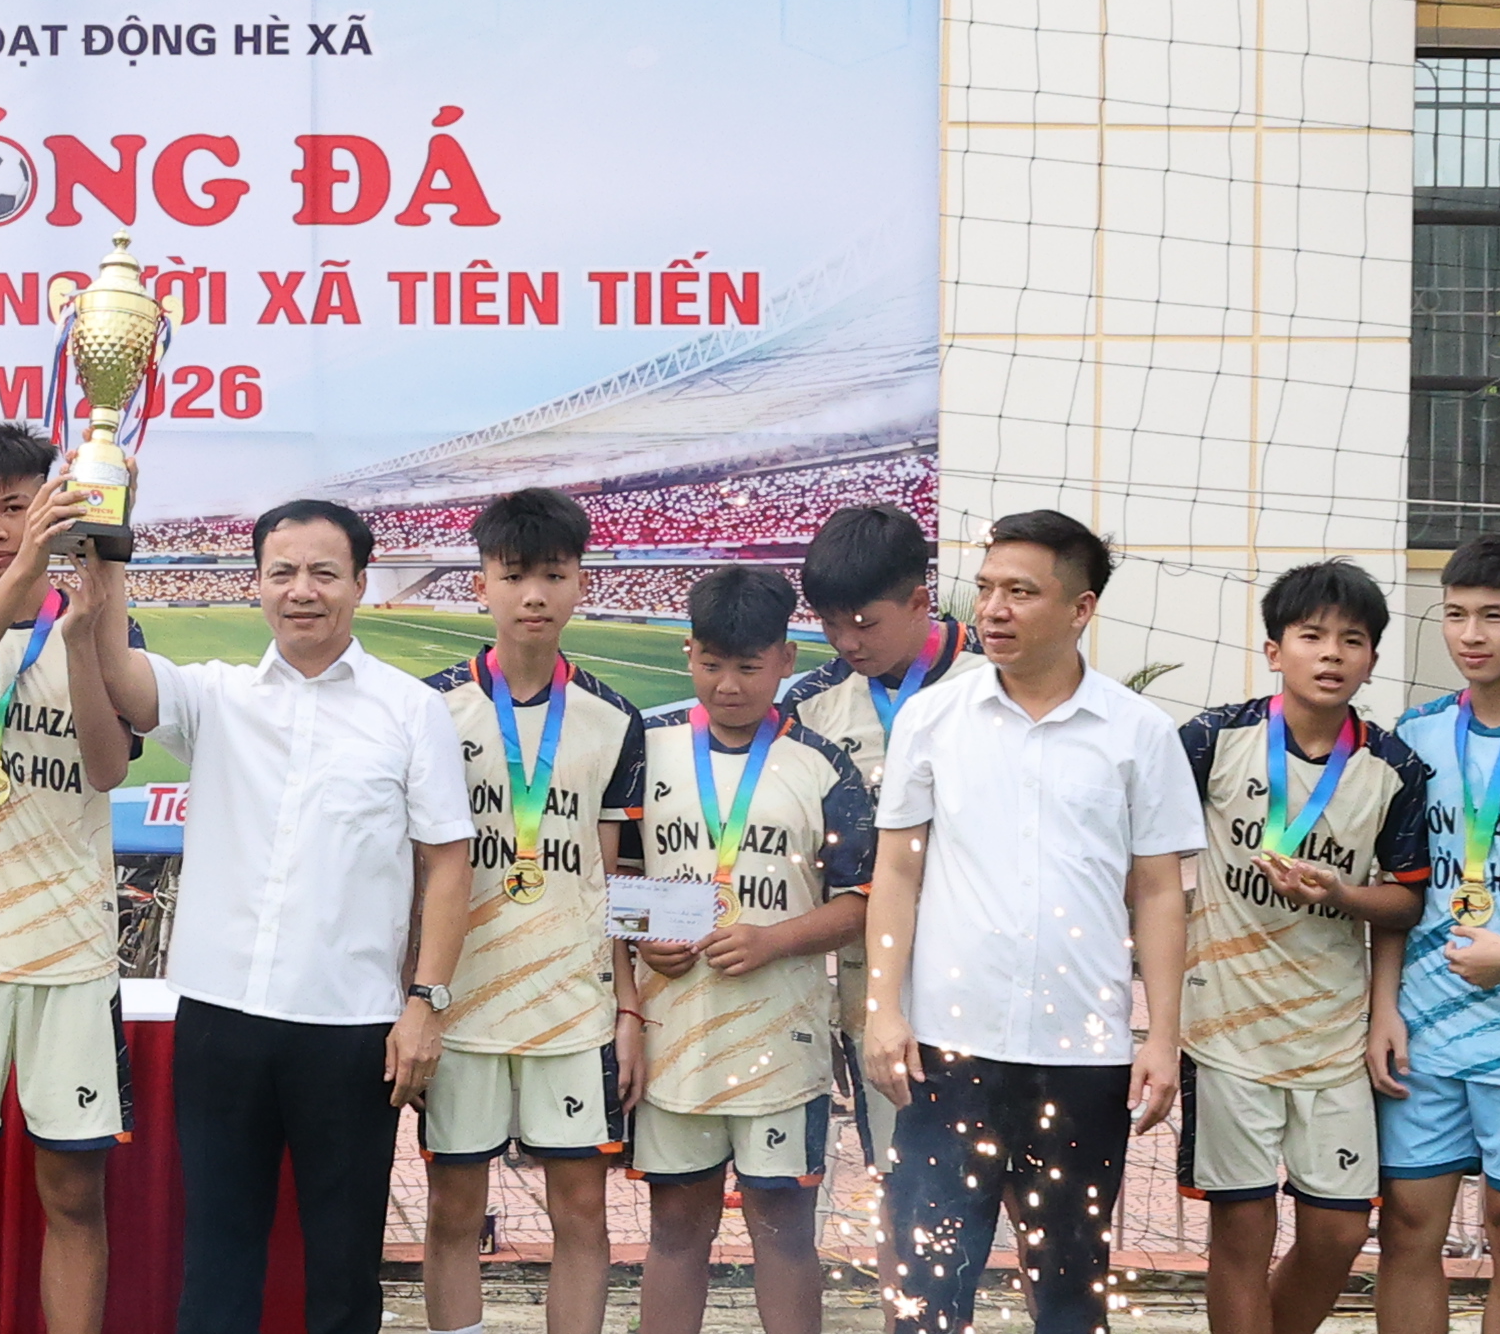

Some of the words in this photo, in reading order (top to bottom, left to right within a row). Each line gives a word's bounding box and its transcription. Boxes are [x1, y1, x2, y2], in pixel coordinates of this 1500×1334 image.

[81, 15, 218, 66] ĐỘNG
[234, 15, 291, 56] HÈ
[306, 15, 373, 56] XÃ
[292, 104, 502, 228] ĐÁ
[257, 259, 362, 325] XÃ
[387, 259, 560, 325] TIÊN
[588, 251, 761, 325] TIẾN
[31, 755, 82, 794] HOA
[468, 779, 504, 815] ƠN
[656, 816, 699, 855] SƠN
[1231, 817, 1266, 850] SƠ
[739, 875, 788, 911] HOA
